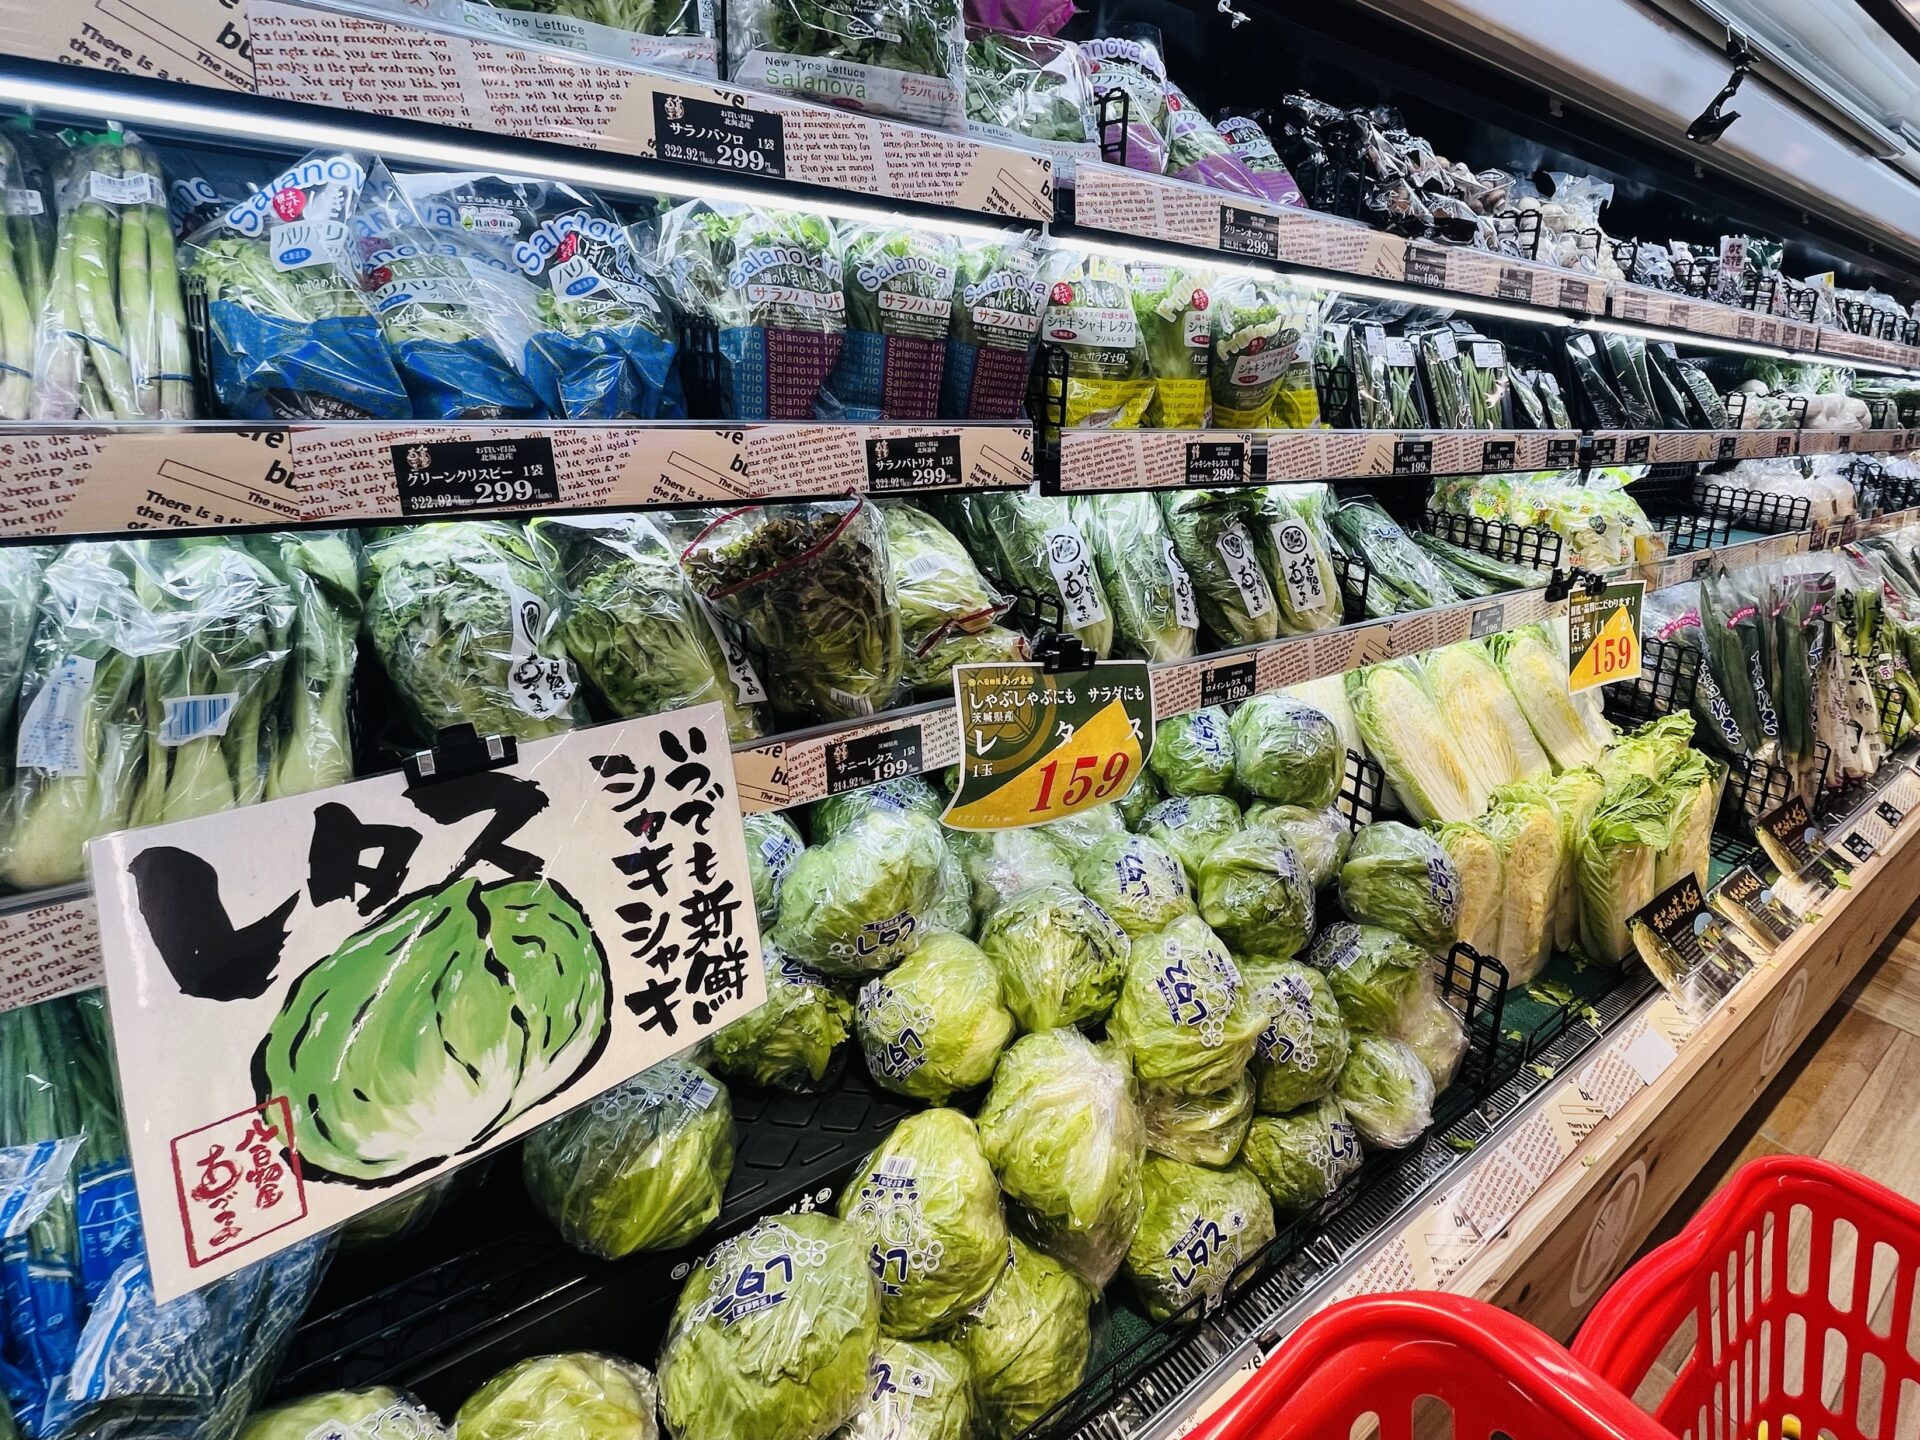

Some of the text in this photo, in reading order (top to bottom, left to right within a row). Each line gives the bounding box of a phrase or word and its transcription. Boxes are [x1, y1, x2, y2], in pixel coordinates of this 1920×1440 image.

[497, 12, 585, 36] Type Lettuce
[70, 38, 101, 62] the
[82, 22, 132, 59] There
[198, 51, 222, 72] The
[765, 56, 789, 68] New
[796, 59, 822, 72] Type
[826, 62, 866, 80] Lettuce
[766, 68, 867, 99] Salanova
[669, 122, 744, 146] サラノバソロ
[664, 143, 766, 172] 322.92 299
[1223, 224, 1263, 239] グリーンオーク
[1246, 238, 1269, 256] 299
[730, 247, 823, 288] Salanova
[860, 257, 948, 290] Salanova
[964, 270, 1046, 305] Salanova
[1424, 273, 1440, 287] 199
[767, 330, 844, 346] Salanova trio
[768, 341, 820, 355] Salanova
[889, 337, 929, 350] Salanova
[769, 351, 820, 365] Salanova
[888, 347, 927, 360] Salanova
[769, 362, 820, 375] Salanova
[769, 373, 820, 386] Salanova
[475, 445, 517, 455] お買い得品
[480, 453, 514, 462] 北海道産
[875, 457, 935, 472] サラノバトリオ
[1212, 467, 1235, 482] 299
[1410, 462, 1427, 473] 199
[407, 464, 544, 487] グリーンクリスピー 1袋
[659, 474, 687, 495] There
[912, 467, 947, 487] 299
[146, 489, 192, 514] There
[247, 491, 271, 508] The
[410, 479, 534, 511] 322.92 299
[136, 505, 164, 522] the
[1592, 636, 1632, 677] 159
[1205, 678, 1242, 693] ロメインレタス
[1226, 684, 1248, 700] 199
[969, 685, 1145, 709] しゃぶしゃぶにも サラダにも
[971, 711, 1015, 724] 茨城県産
[836, 752, 895, 775] サニーレタス
[972, 762, 993, 779] 1玉
[833, 759, 909, 793] 214.92 199
[1029, 751, 1131, 814] 159
[659, 726, 750, 1026] いつでも新鮮
[127, 771, 551, 1003] レタス
[588, 754, 678, 1038] シャキシャキ
[1164, 959, 1208, 1029] レタス
[1170, 1221, 1230, 1290] レタス
